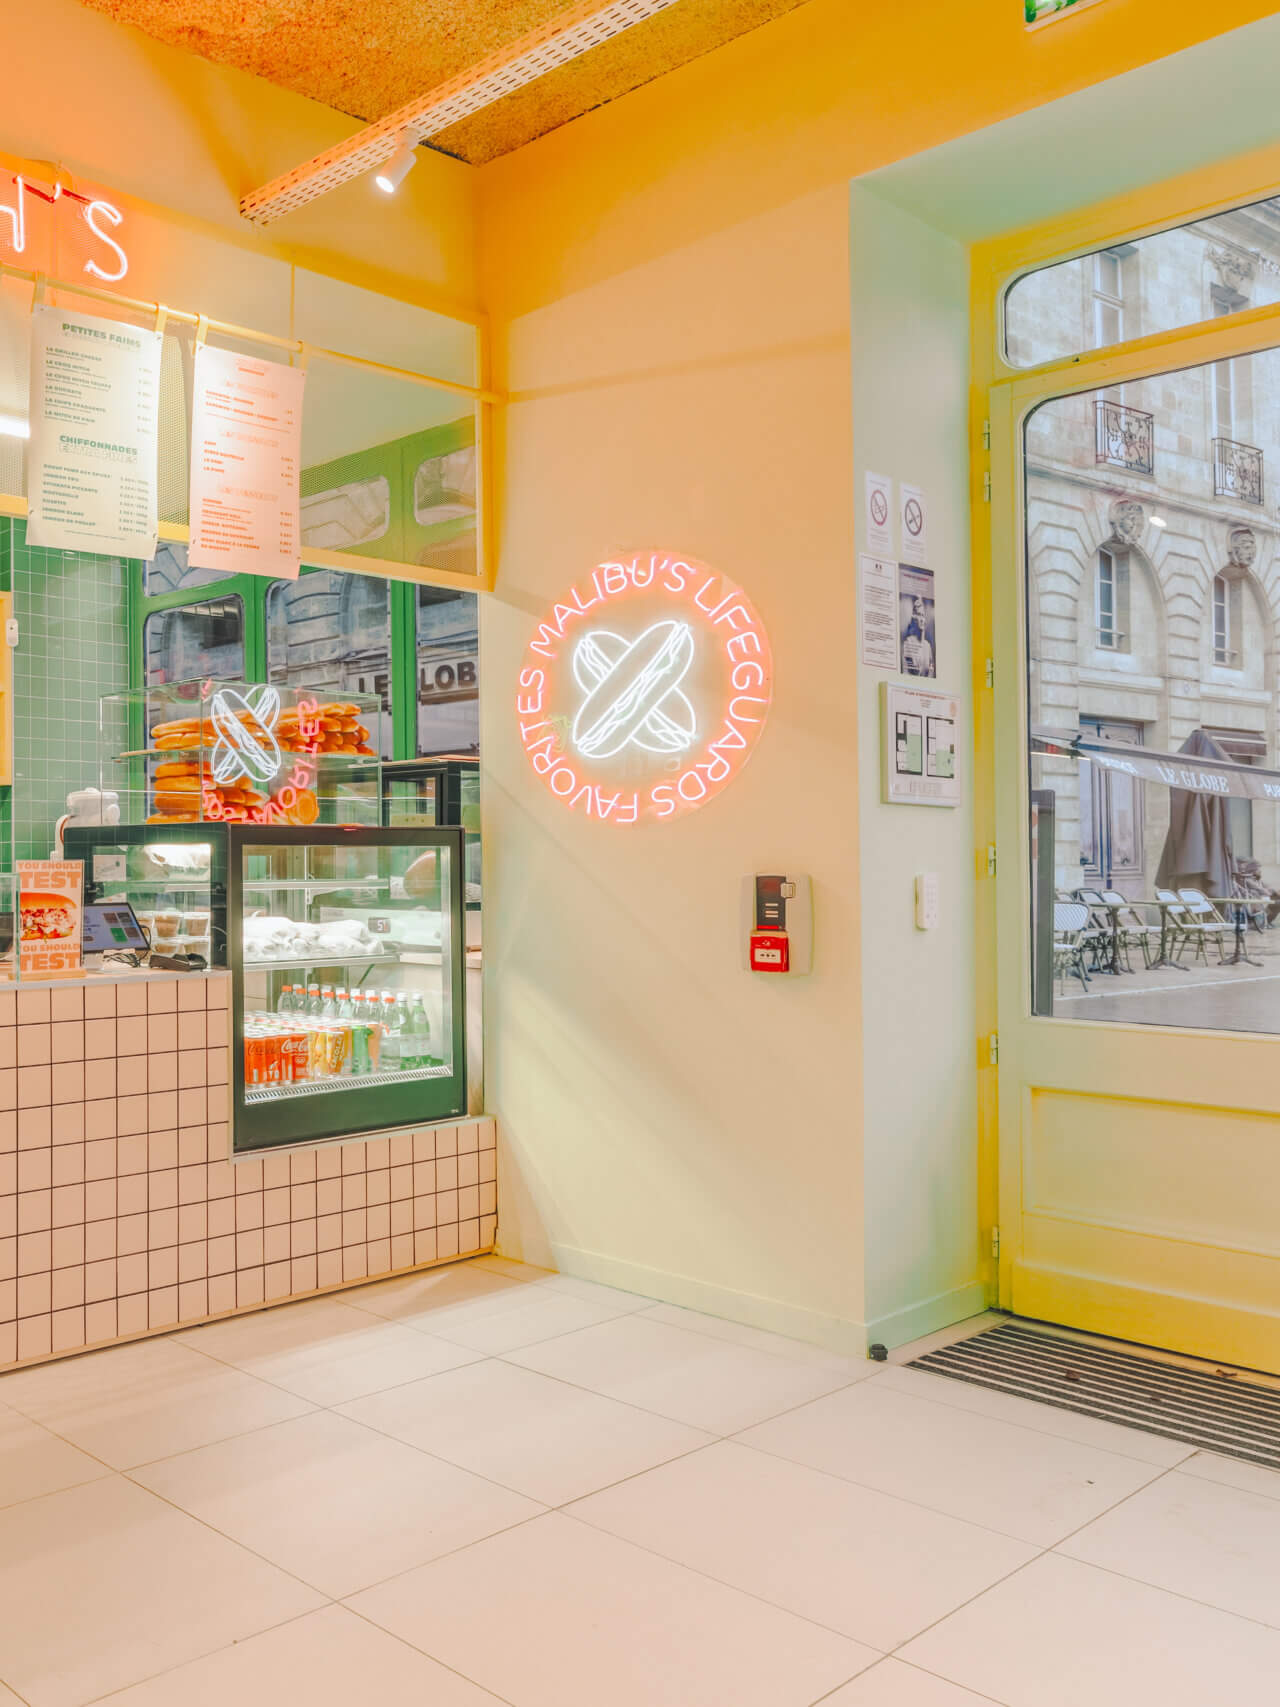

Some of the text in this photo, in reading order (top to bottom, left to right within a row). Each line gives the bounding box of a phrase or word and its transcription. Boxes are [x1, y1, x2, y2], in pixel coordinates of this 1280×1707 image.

[62, 322, 107, 341] PETITES
[59, 434, 138, 457] CHIFFONNADES
[420, 661, 477, 692] LOB
[517, 555, 768, 823] MALIBU'S LIFEGUARDS FAVORITES
[1180, 770, 1230, 793] GLOBE
[19, 871, 81, 889] TEST
[22, 944, 38, 952] OU
[19, 952, 81, 971] TEST
